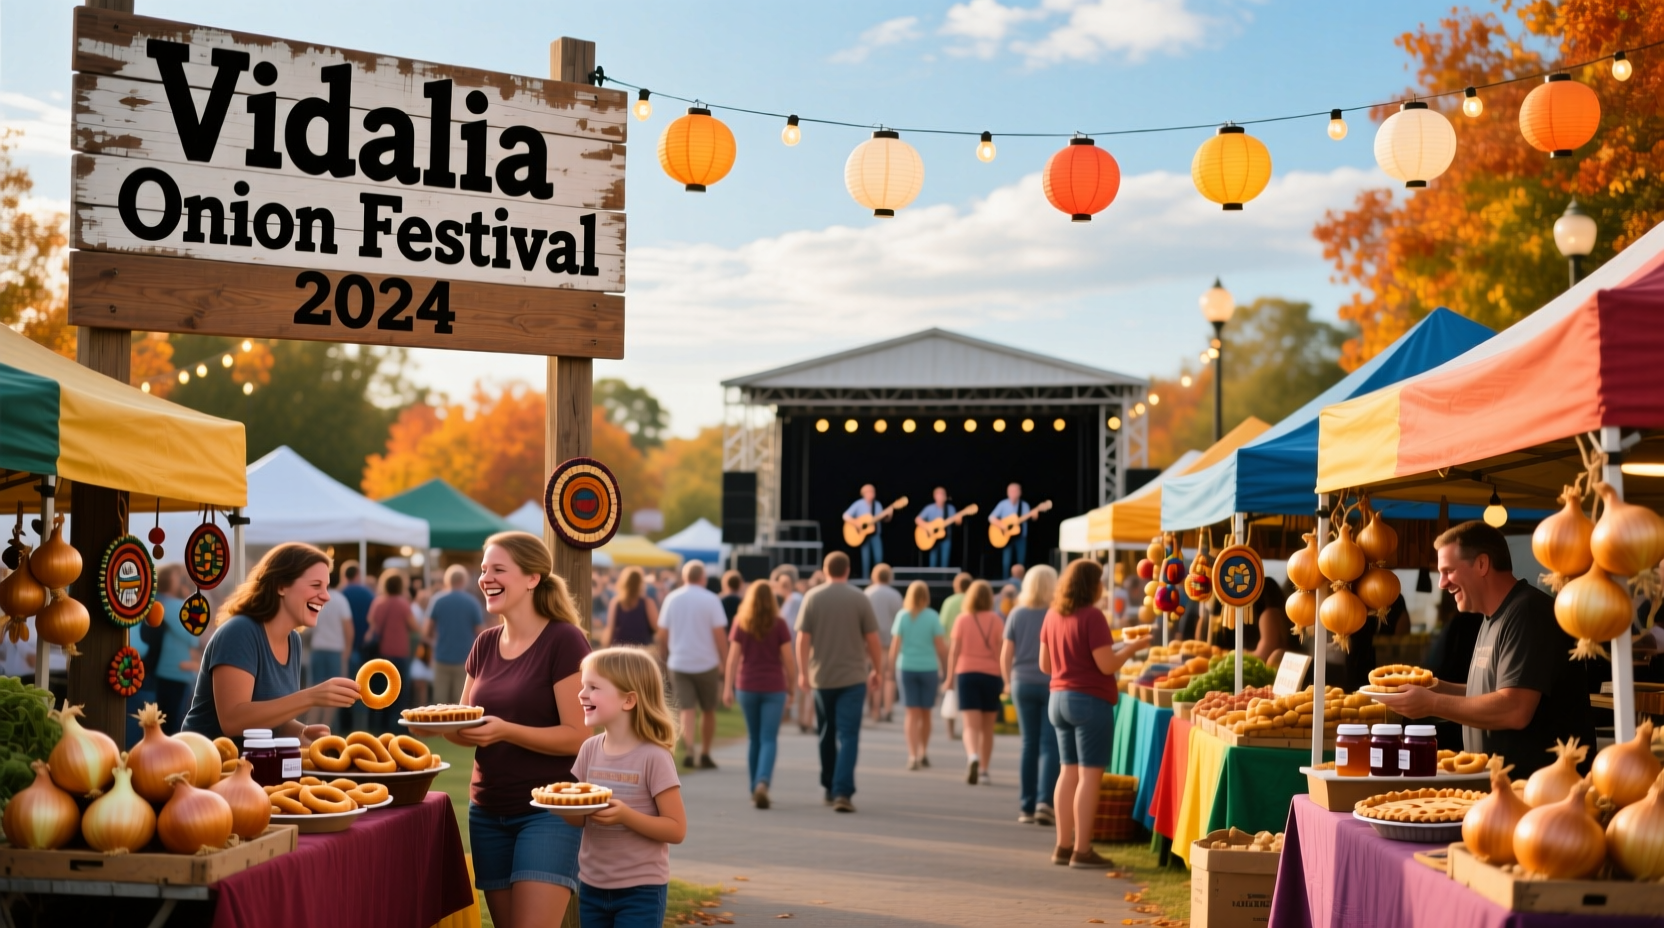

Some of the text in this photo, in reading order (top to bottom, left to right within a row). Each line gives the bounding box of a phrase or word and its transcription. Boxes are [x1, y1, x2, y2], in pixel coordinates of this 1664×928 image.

[146, 38, 554, 200] Vidalia
[117, 167, 599, 276] Onion Festival
[293, 270, 456, 335] 2024
